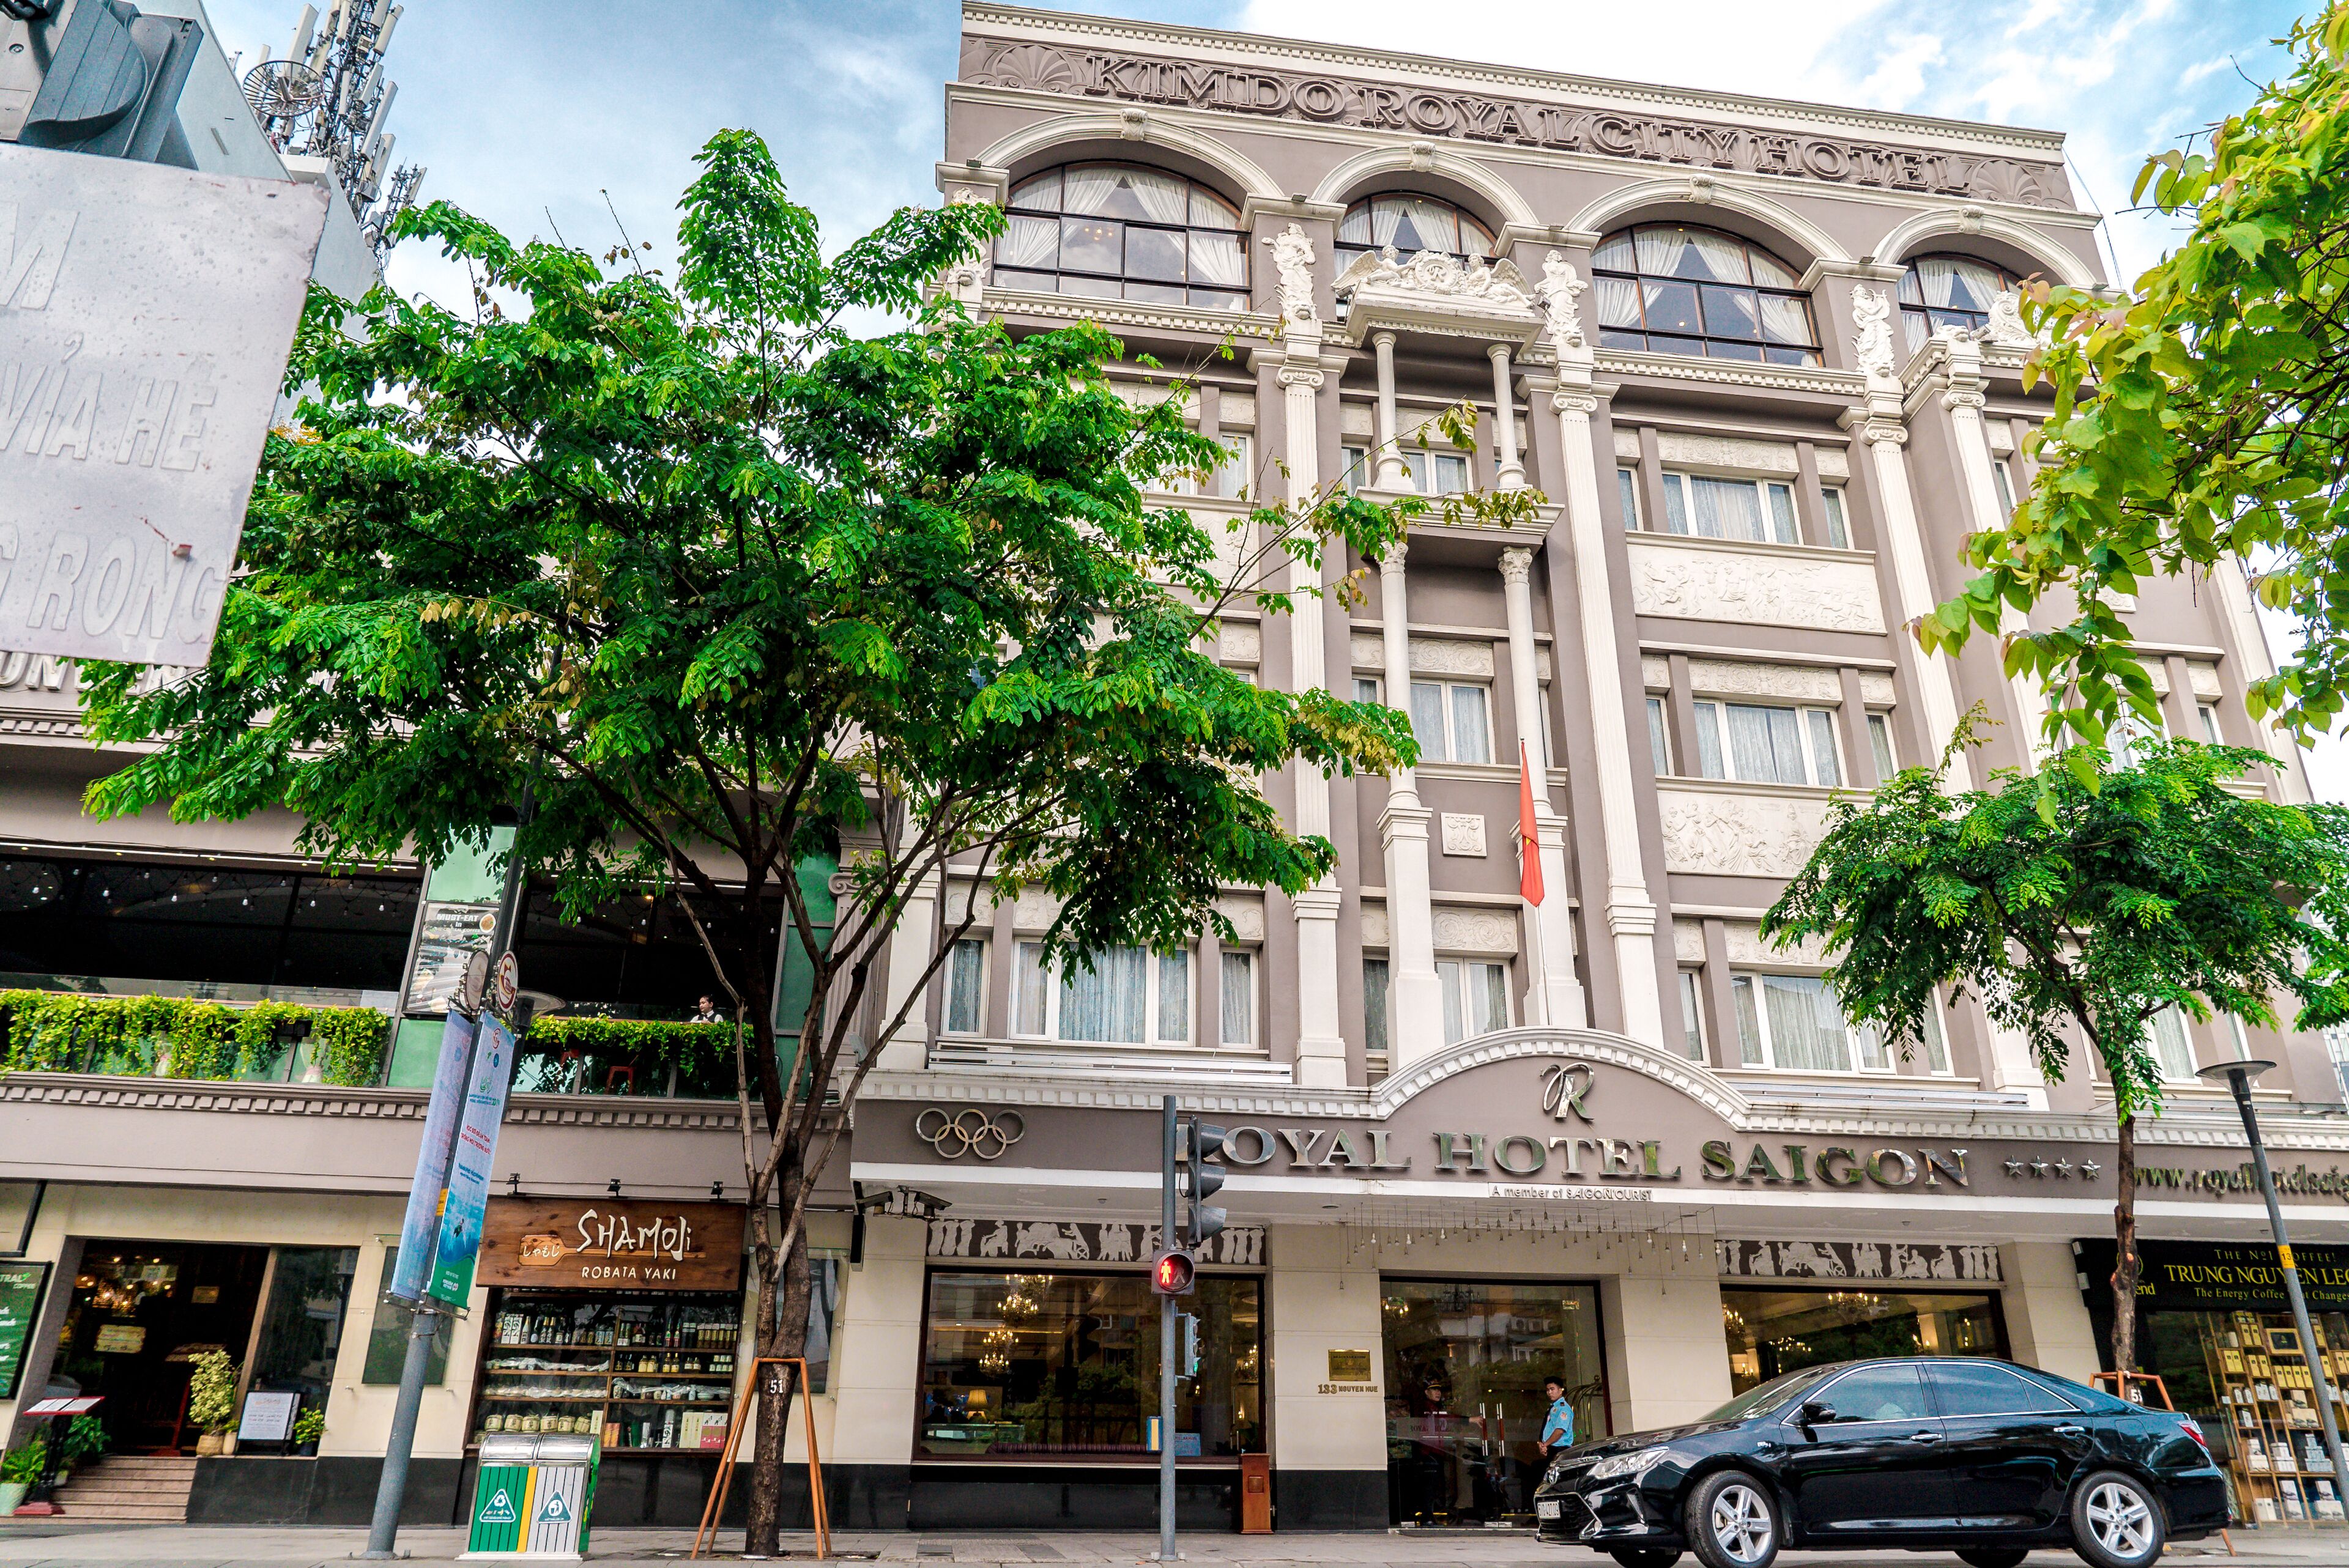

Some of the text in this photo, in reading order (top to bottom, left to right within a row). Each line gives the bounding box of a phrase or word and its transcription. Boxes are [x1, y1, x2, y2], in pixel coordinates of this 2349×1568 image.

[1357, 86, 1580, 152] ROYAL
[1590, 114, 1739, 169] CITY
[1750, 133, 1972, 196] HOTEL
[437, 914, 479, 922] MUST-EAT
[1433, 1132, 1681, 1177] HOTEL
[1700, 1140, 1969, 1186] SAIGON
[1493, 1185, 1500, 1196] A
[1504, 1186, 1549, 1197] member
[1553, 1188, 1563, 1198] of
[523, 1244, 560, 1258] しゃもじ
[2214, 1249, 2241, 1260] THE
[2292, 1252, 2337, 1263] OFFEE!
[2281, 1252, 2291, 1261] 13
[581, 1266, 677, 1281] ROBATA YAKI
[2164, 1264, 2233, 1284] TRUNG
[2194, 1287, 2213, 1298] The
[2216, 1288, 2249, 1300] Energy
[2252, 1289, 2285, 1300] Coffee
[770, 1379, 784, 1394] 51
[1318, 1384, 1338, 1394] 133
